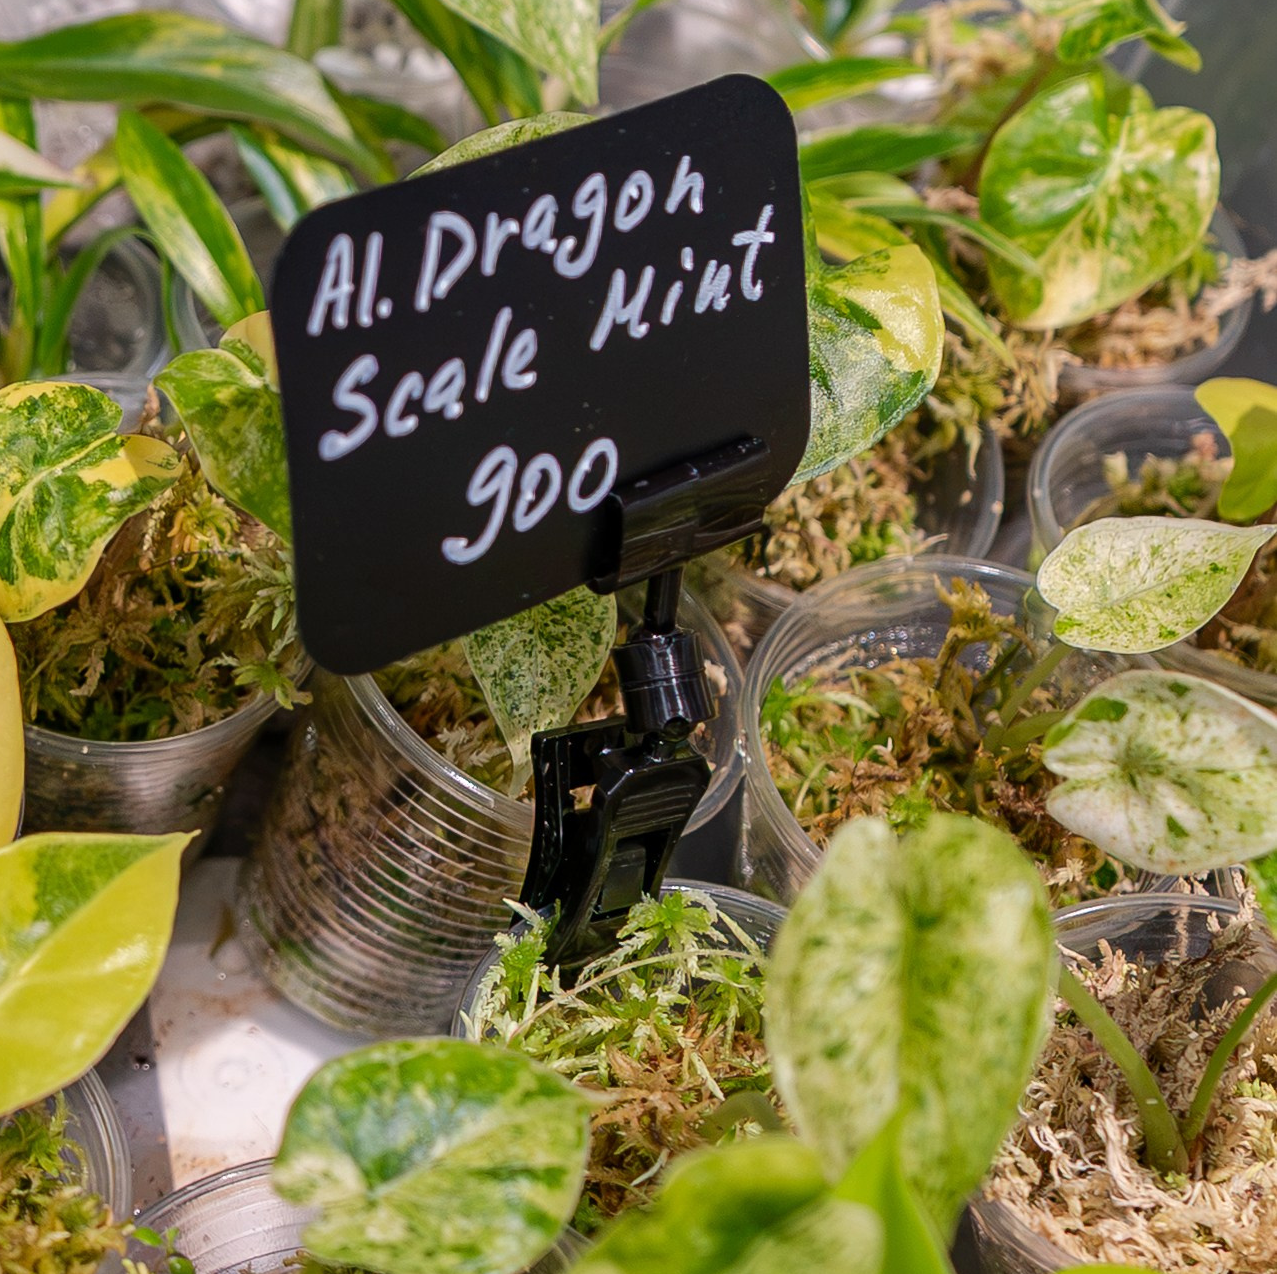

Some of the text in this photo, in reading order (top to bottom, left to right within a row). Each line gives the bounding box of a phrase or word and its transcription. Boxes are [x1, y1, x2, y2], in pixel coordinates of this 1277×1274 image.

[307, 155, 705, 336] Al. Dragon
[319, 203, 776, 461] Scale Mint
[441, 437, 619, 564] 900
